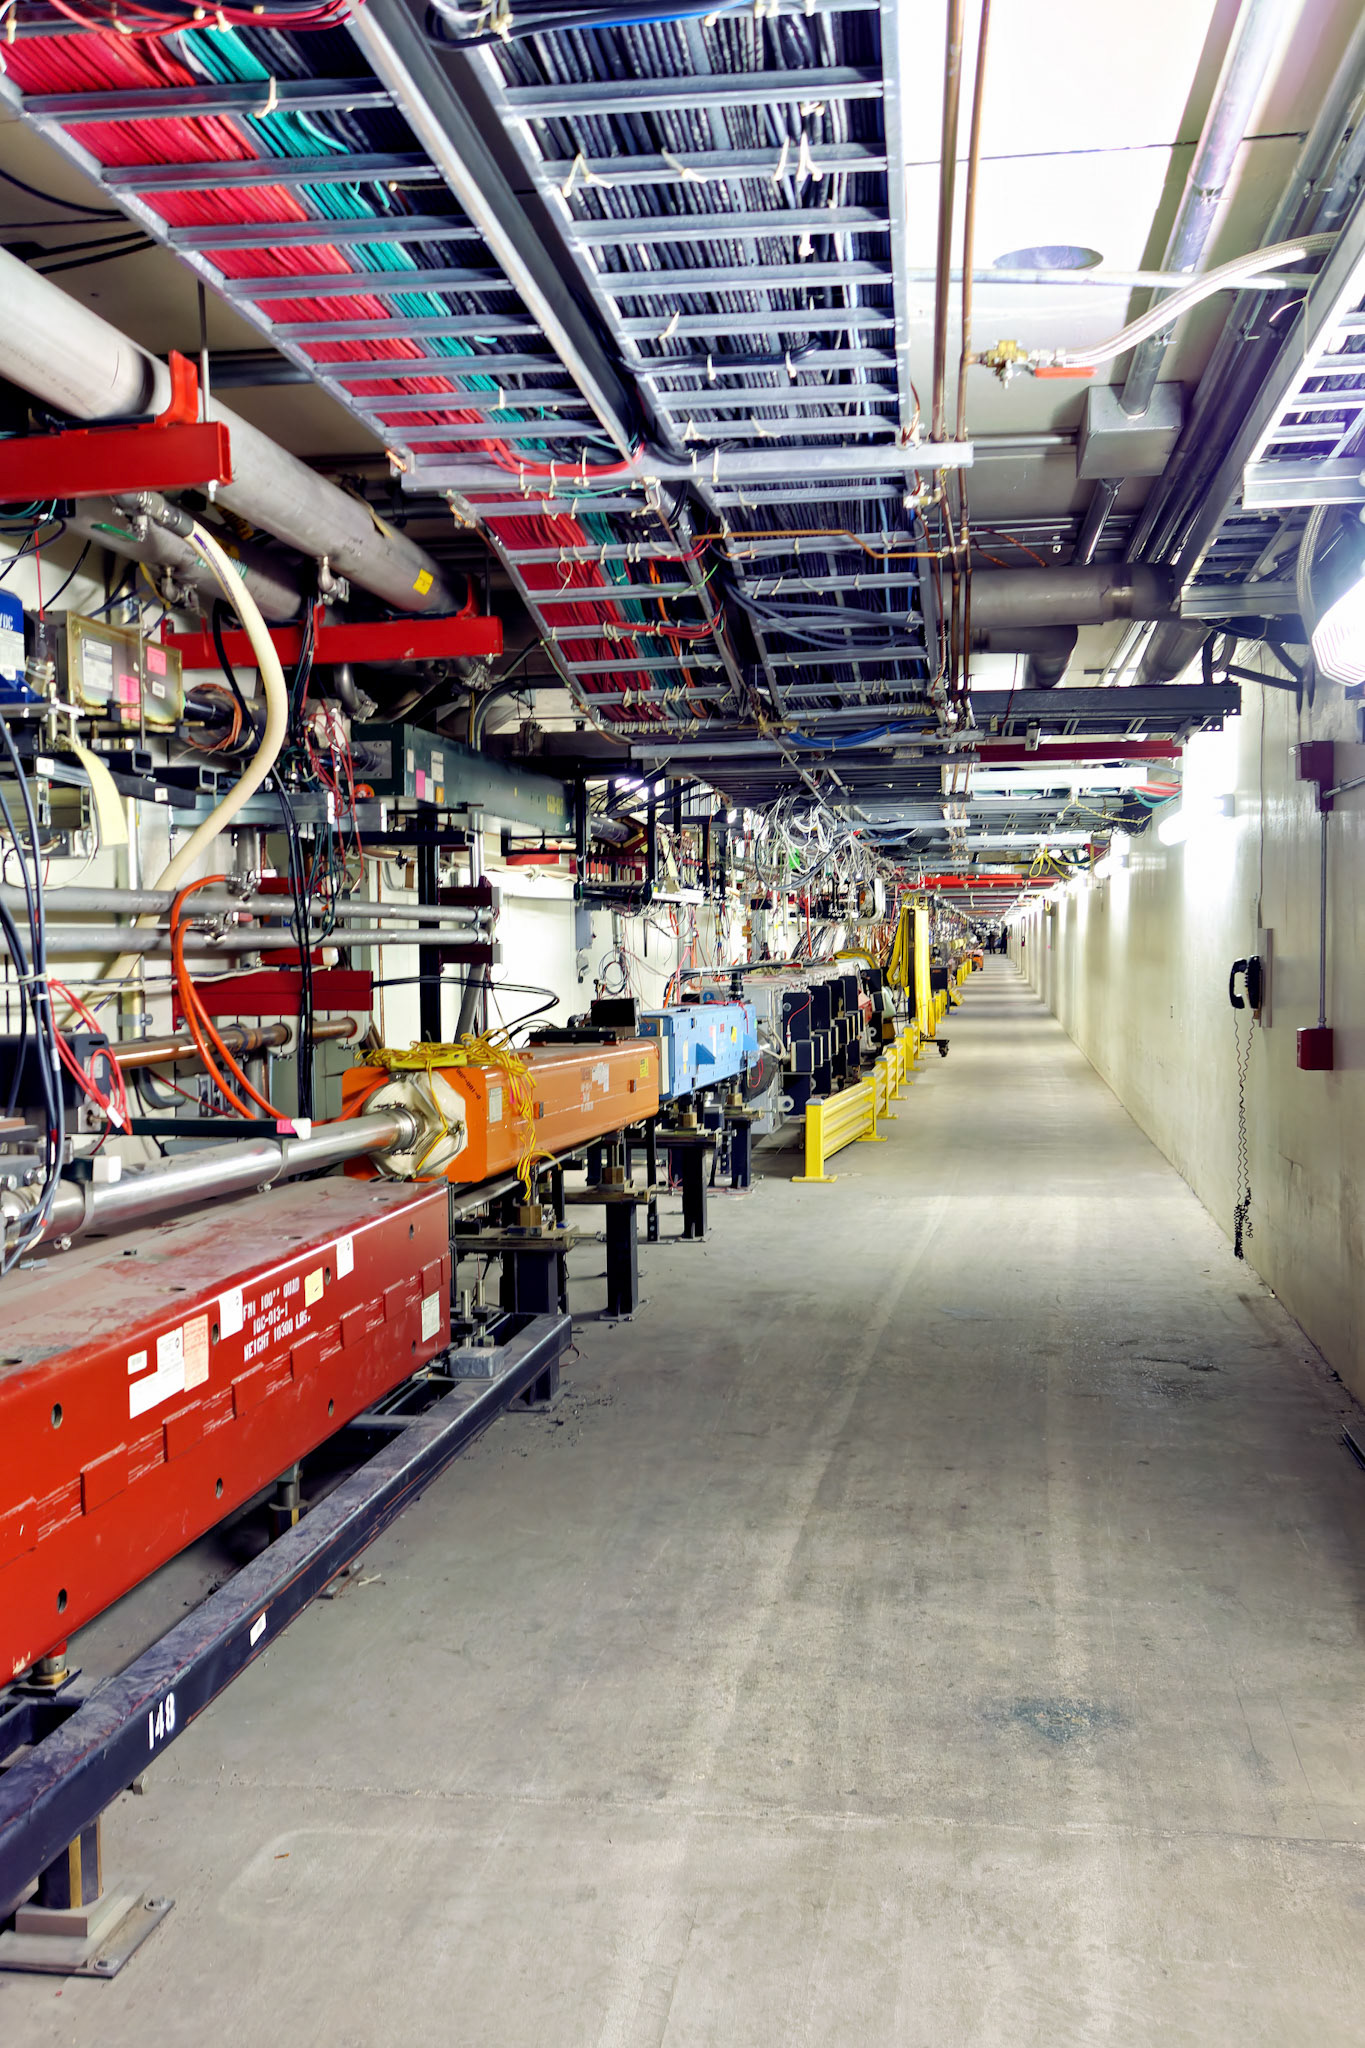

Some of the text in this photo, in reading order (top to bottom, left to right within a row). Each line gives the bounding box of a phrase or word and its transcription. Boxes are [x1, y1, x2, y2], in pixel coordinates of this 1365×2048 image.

[283, 1276, 300, 1298] QUAD
[244, 1331, 270, 1363] WEIGHT
[148, 1692, 176, 1750] 148
